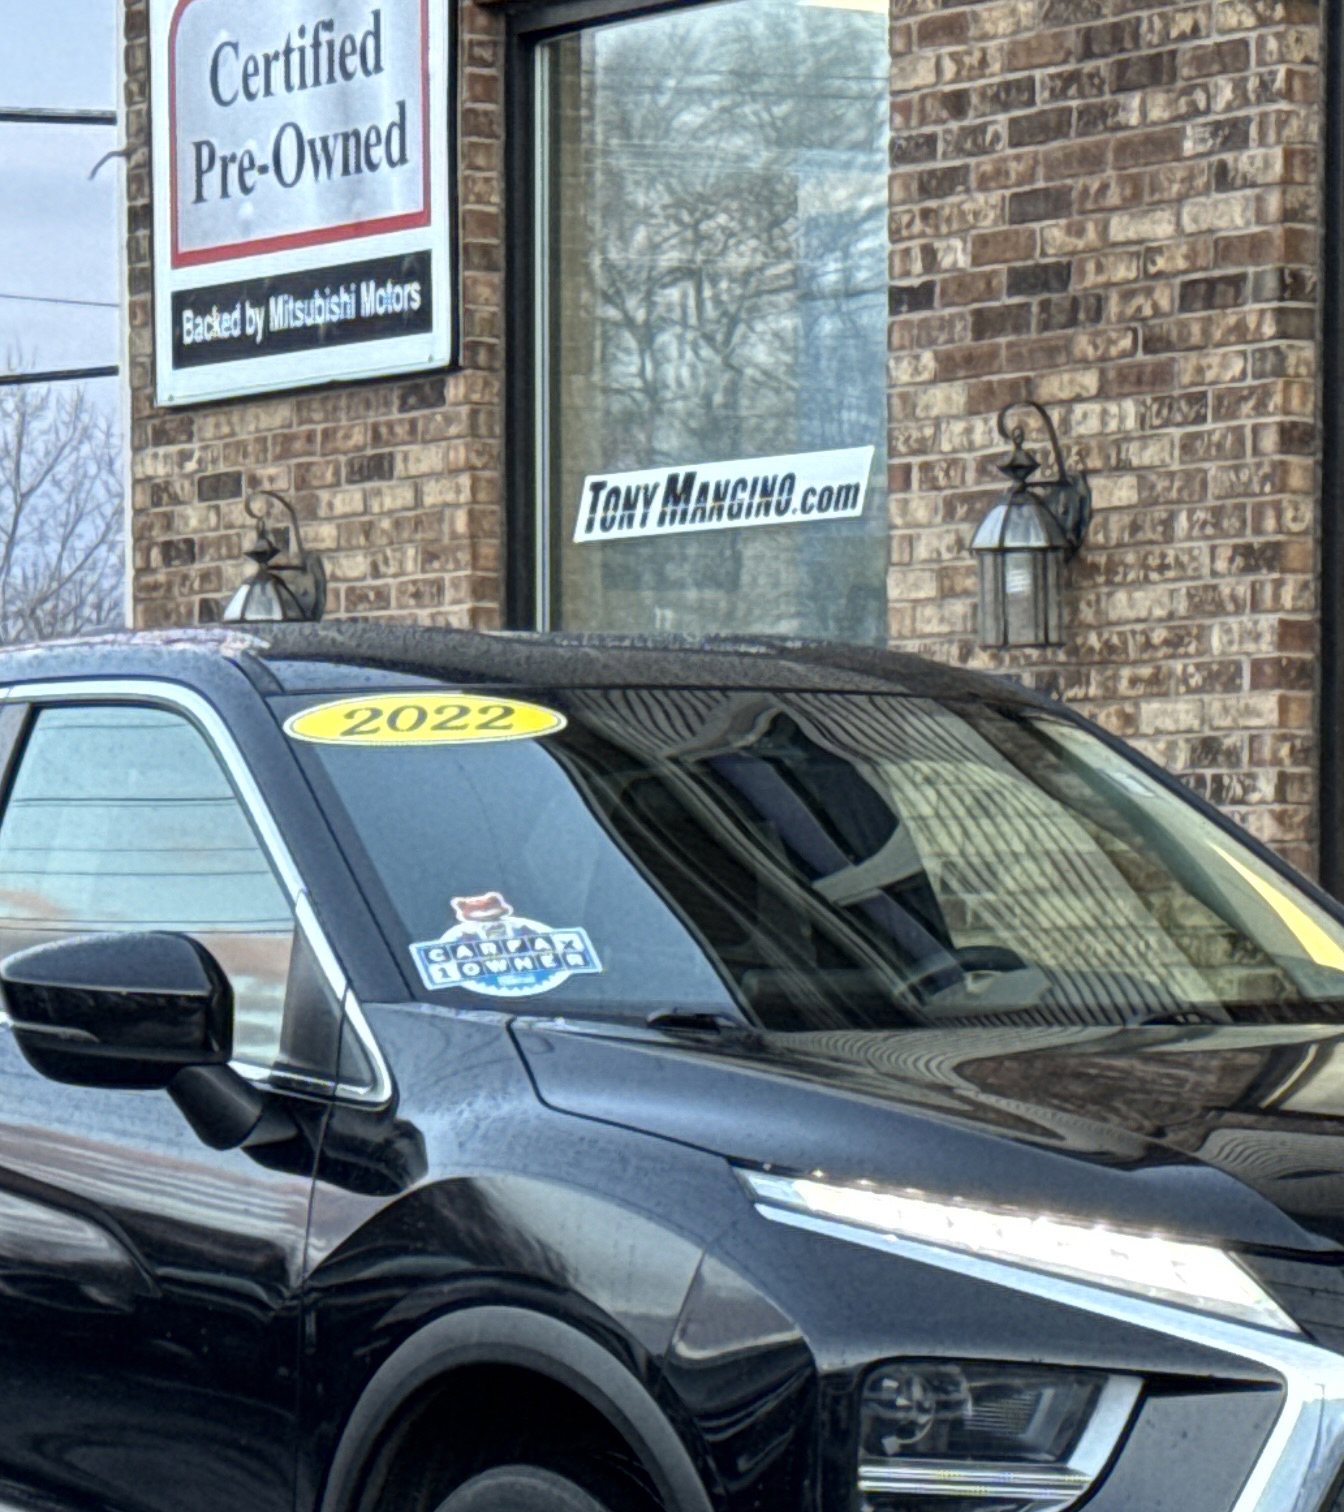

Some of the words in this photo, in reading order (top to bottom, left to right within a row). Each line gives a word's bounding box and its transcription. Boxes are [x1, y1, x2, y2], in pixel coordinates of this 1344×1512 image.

[210, 9, 383, 107] Certified
[191, 99, 408, 204] Pre-Owned
[182, 302, 242, 345] Backed
[245, 299, 265, 344] by
[269, 282, 356, 332] Mitsubishi
[360, 279, 422, 317] Motors
[339, 705, 515, 737] 2022
[428, 936, 579, 963] CARFAX
[461, 953, 586, 977] OWNER
